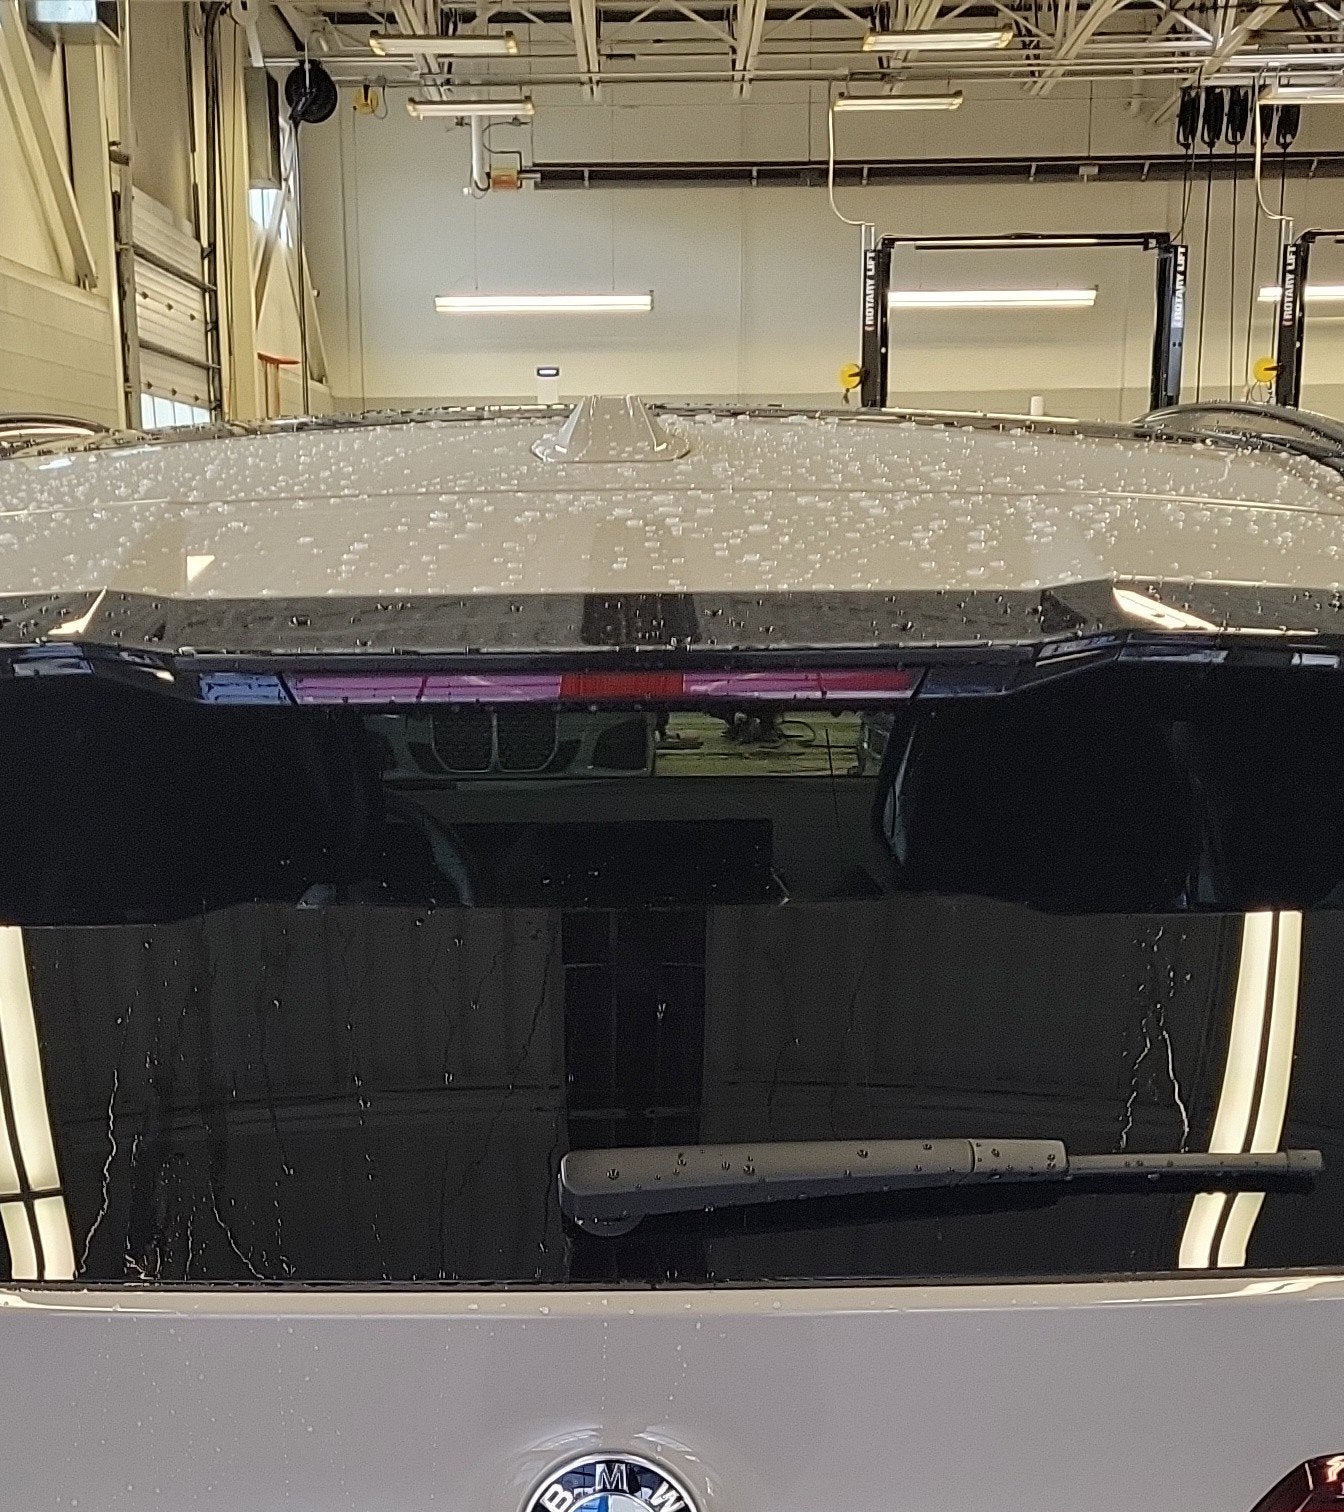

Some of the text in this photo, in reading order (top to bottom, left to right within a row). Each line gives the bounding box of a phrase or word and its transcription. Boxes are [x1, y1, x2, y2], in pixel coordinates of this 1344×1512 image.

[865, 251, 876, 325] ROTARY LIFT
[1282, 245, 1297, 319] ROTARY LIFT
